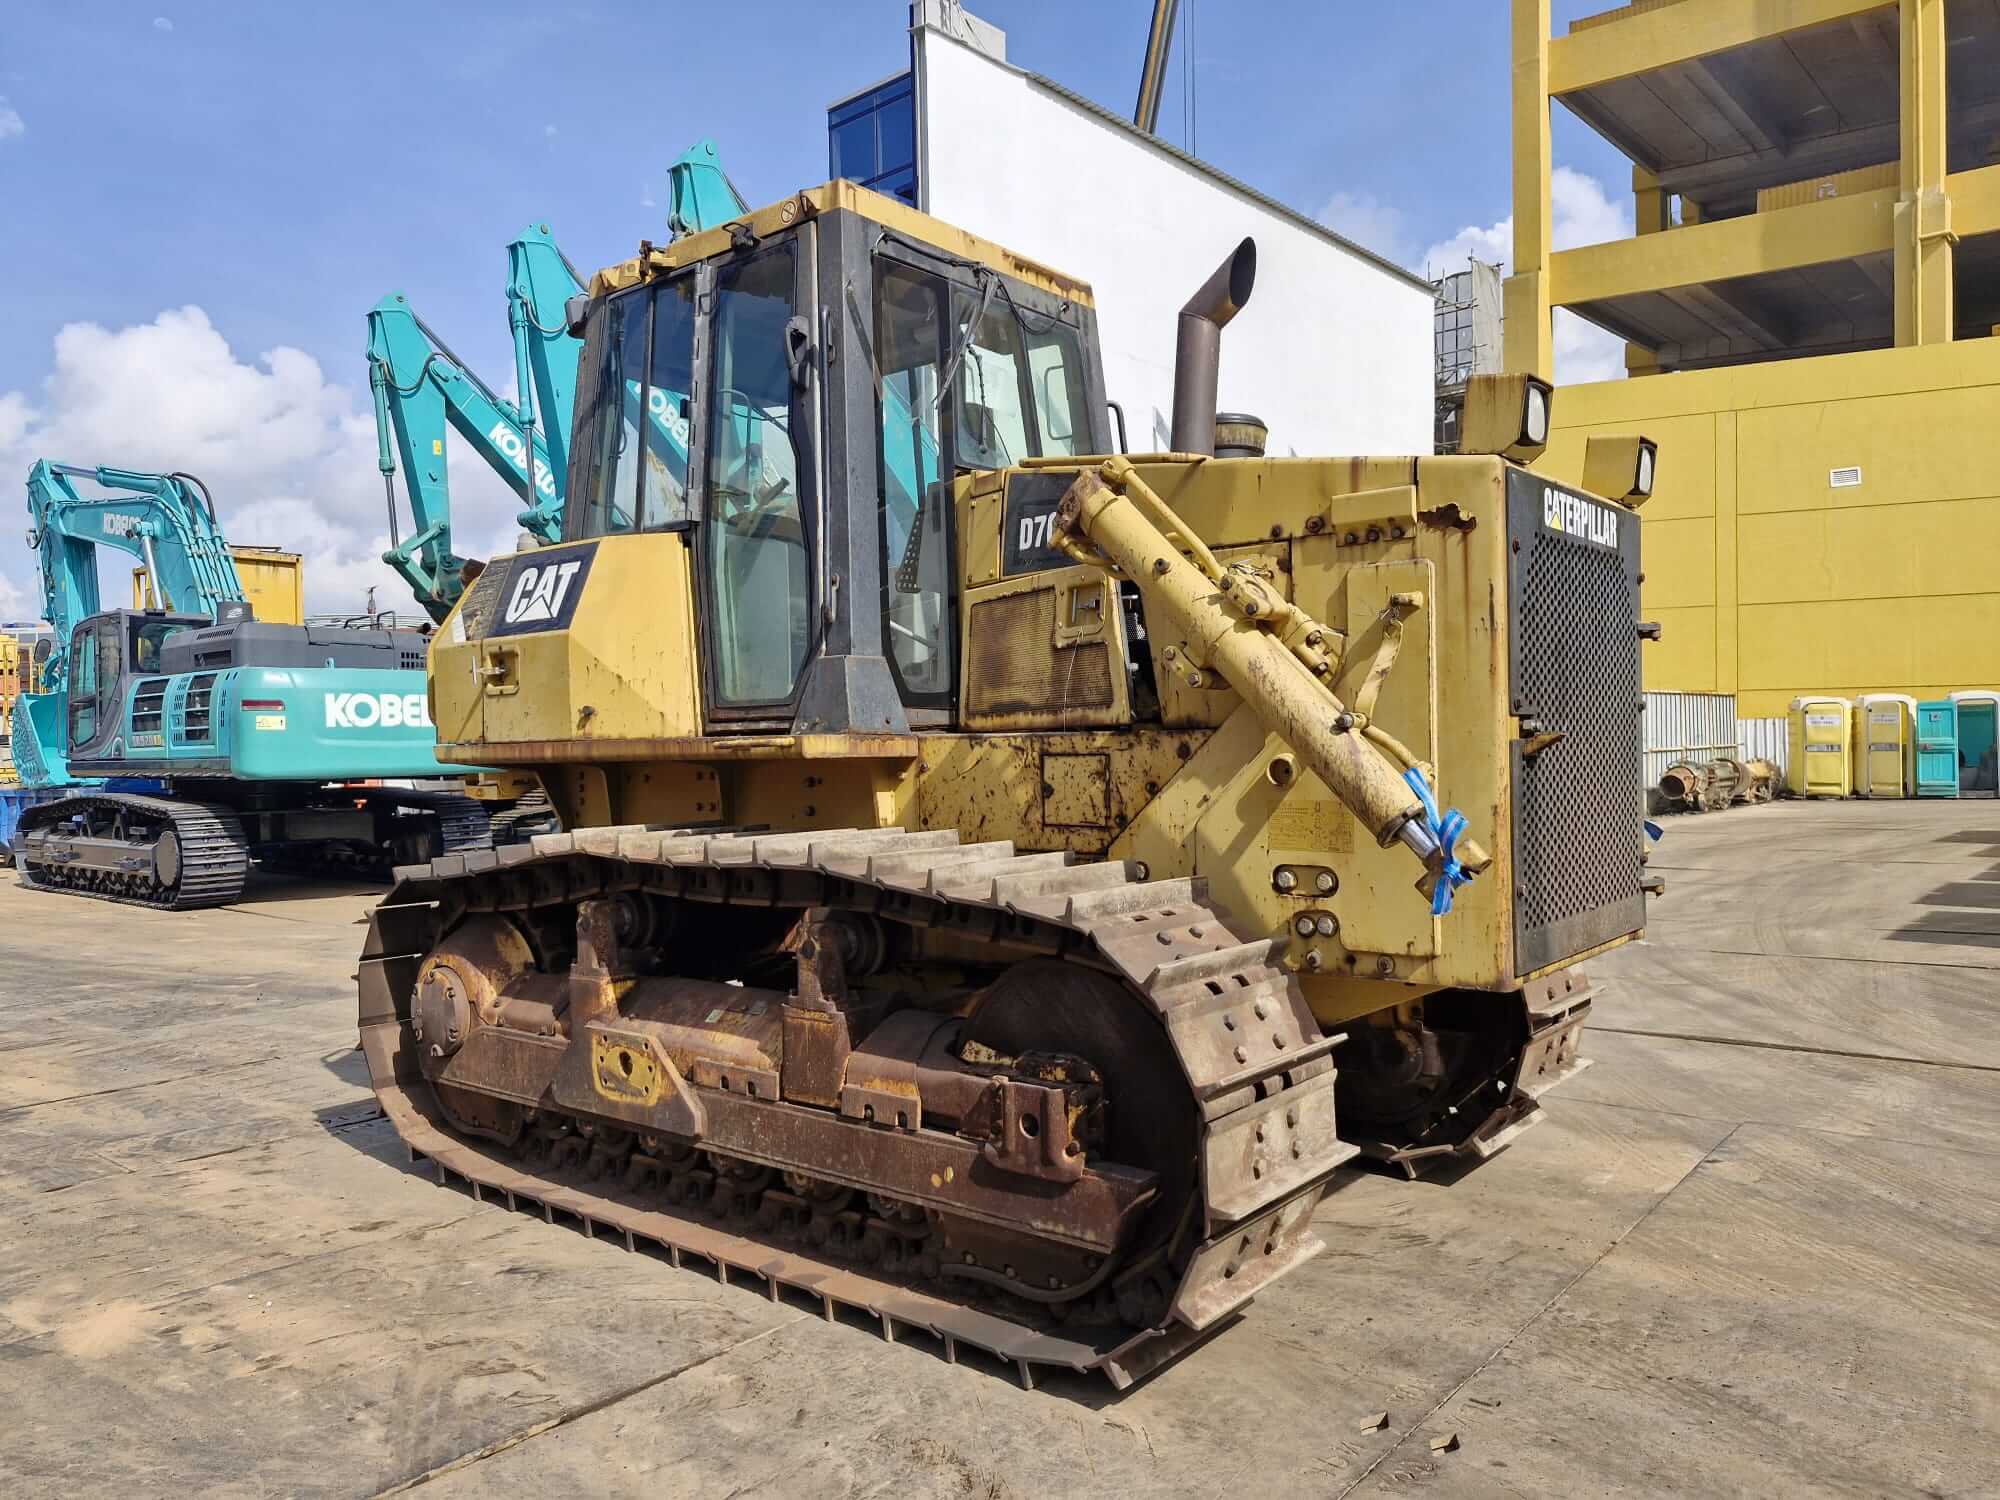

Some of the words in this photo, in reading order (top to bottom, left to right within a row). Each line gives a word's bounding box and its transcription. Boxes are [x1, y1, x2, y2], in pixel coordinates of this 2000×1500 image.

[634, 383, 689, 449] OBE
[488, 421, 557, 495] KOBELC
[1544, 487, 1617, 549] CATERPILLAR
[505, 561, 581, 623] CAT
[324, 692, 435, 728] KOBEL
